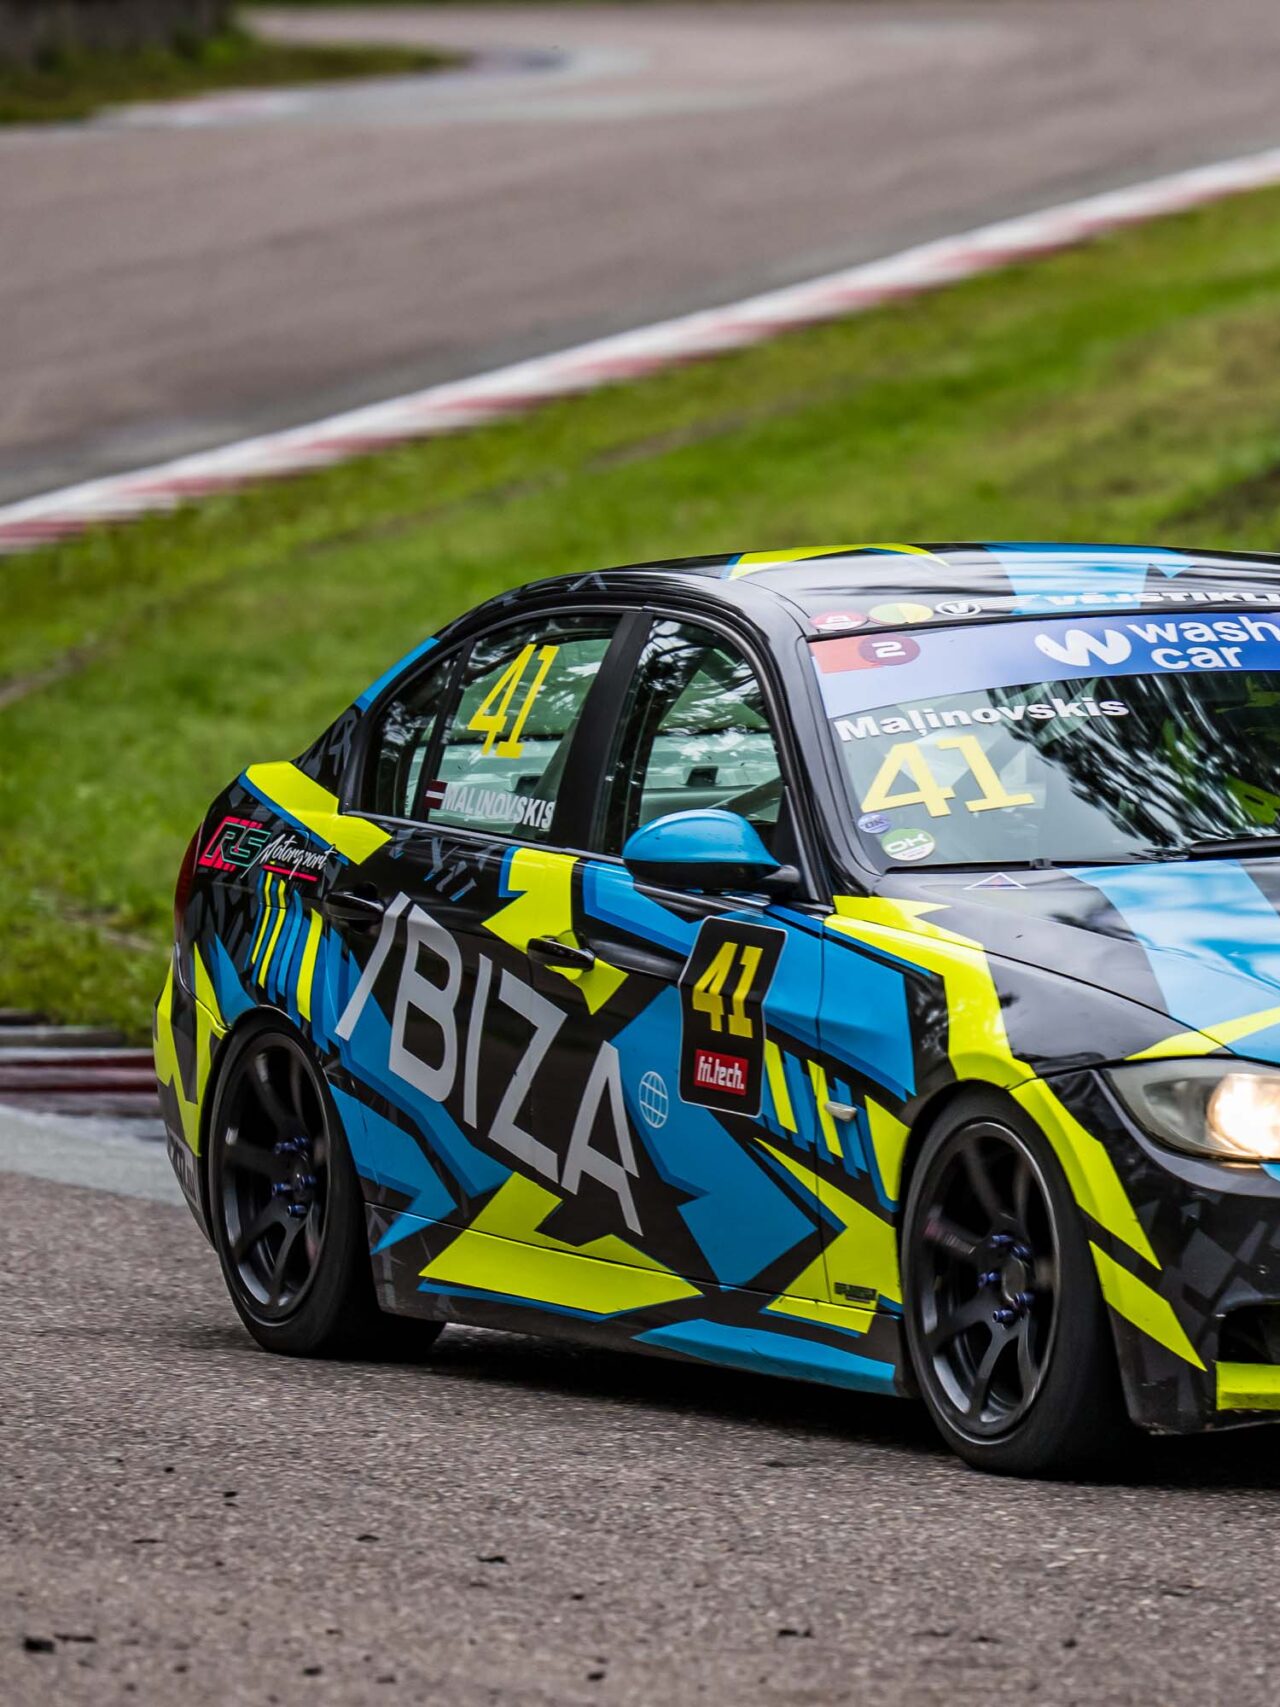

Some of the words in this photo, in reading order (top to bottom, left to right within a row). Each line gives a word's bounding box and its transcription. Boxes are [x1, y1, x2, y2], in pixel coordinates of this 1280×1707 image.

[871, 641, 906, 658] 2
[1151, 646, 1243, 670] car
[467, 644, 560, 760] 41
[860, 735, 1035, 818] 41
[692, 941, 764, 1038] 41
